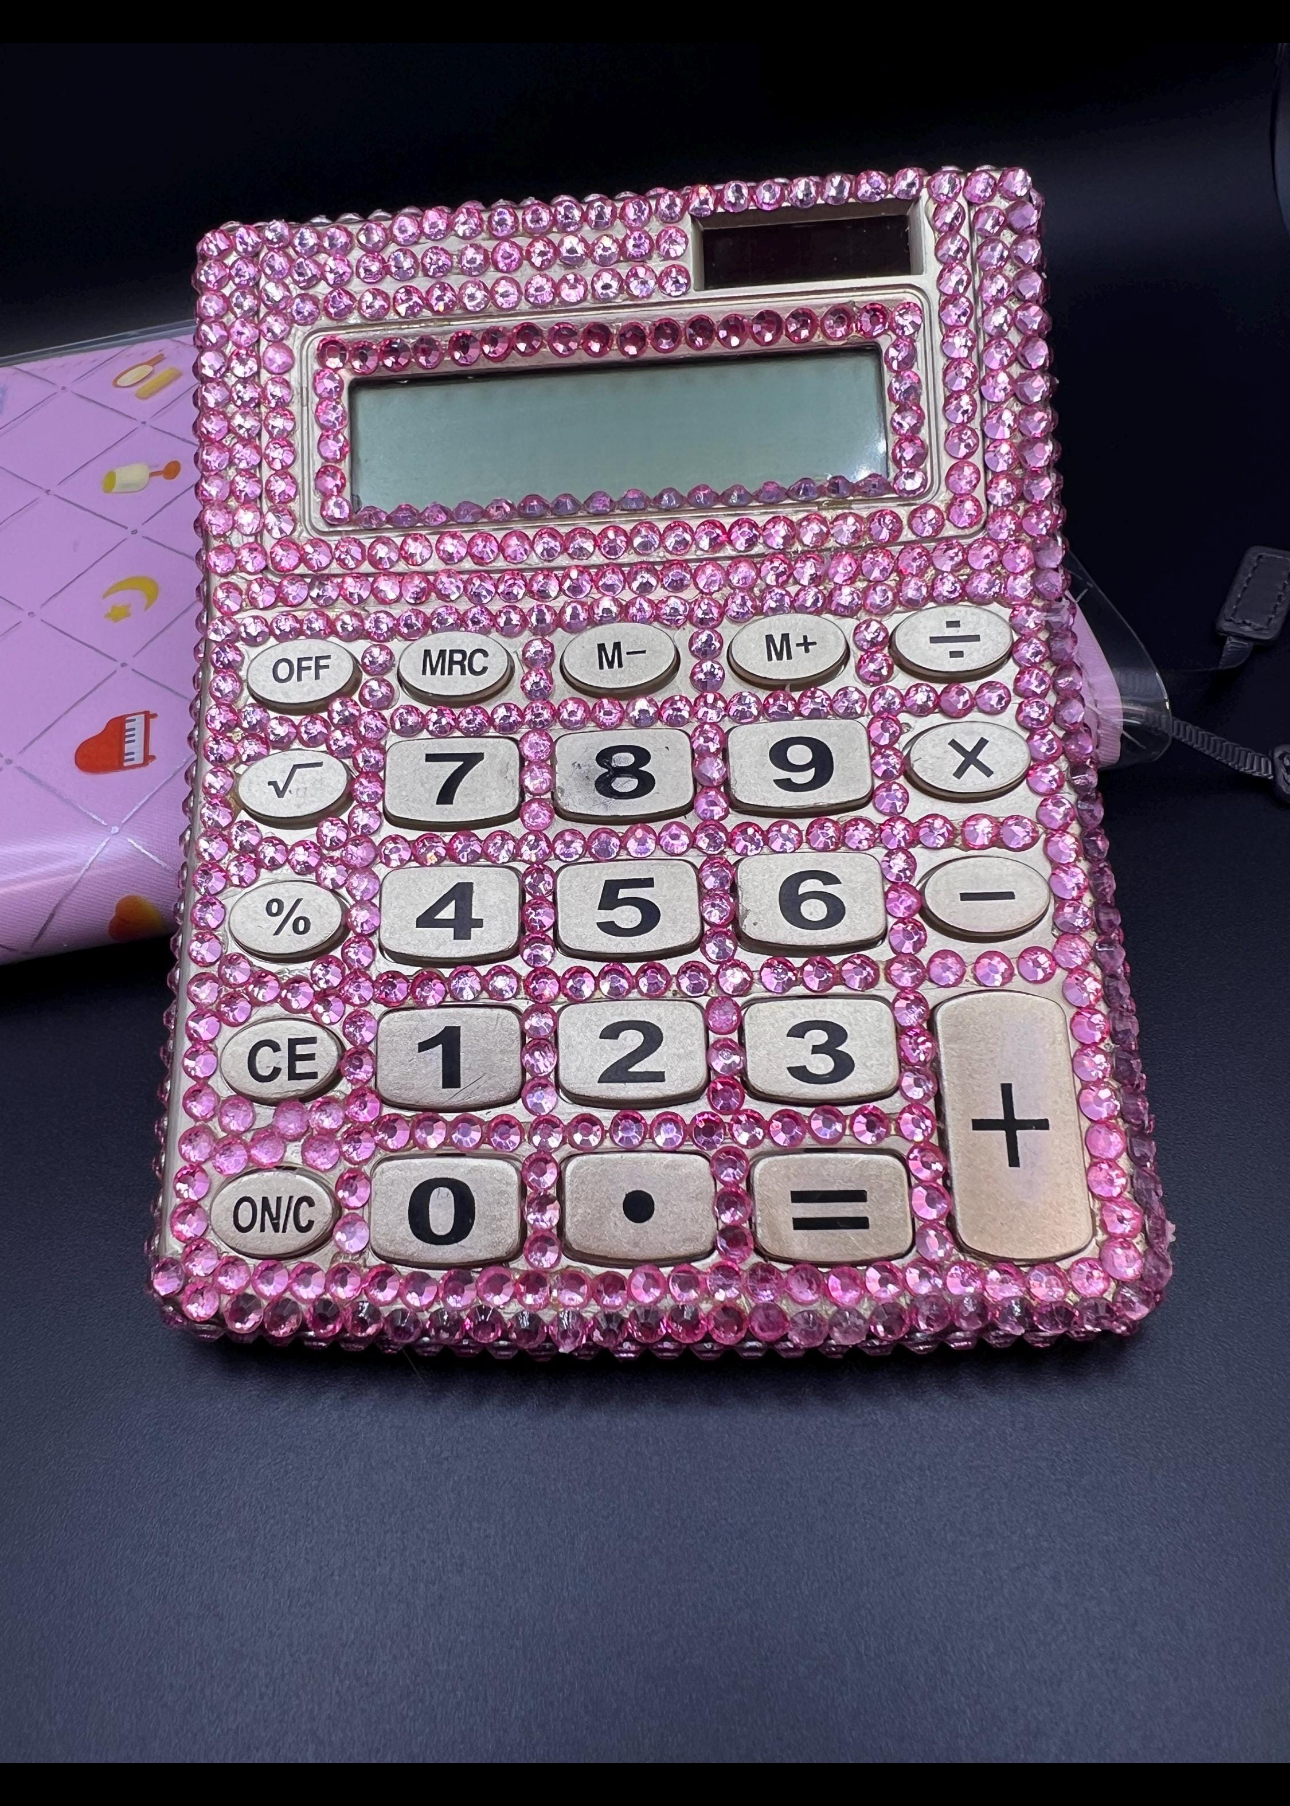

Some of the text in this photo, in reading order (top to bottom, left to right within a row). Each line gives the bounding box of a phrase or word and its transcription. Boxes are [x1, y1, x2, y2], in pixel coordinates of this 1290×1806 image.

[422, 649, 489, 677] MRC
[765, 633, 818, 662] M+
[929, 621, 981, 658] ÷
[272, 655, 331, 684] OFF
[425, 752, 485, 806] 7
[594, 745, 656, 800] 8
[769, 736, 835, 793] 9
[266, 898, 312, 936] %
[416, 882, 484, 941] 4
[597, 878, 662, 938] 5
[779, 870, 846, 931] 6
[248, 1037, 318, 1082] CE
[418, 1026, 462, 1090] 1
[598, 1020, 666, 1085] 2
[787, 1020, 856, 1086] 3
[972, 1083, 1050, 1168] +
[233, 1196, 316, 1235] ON/C
[408, 1178, 475, 1245] 0
[790, 1190, 869, 1231] =
